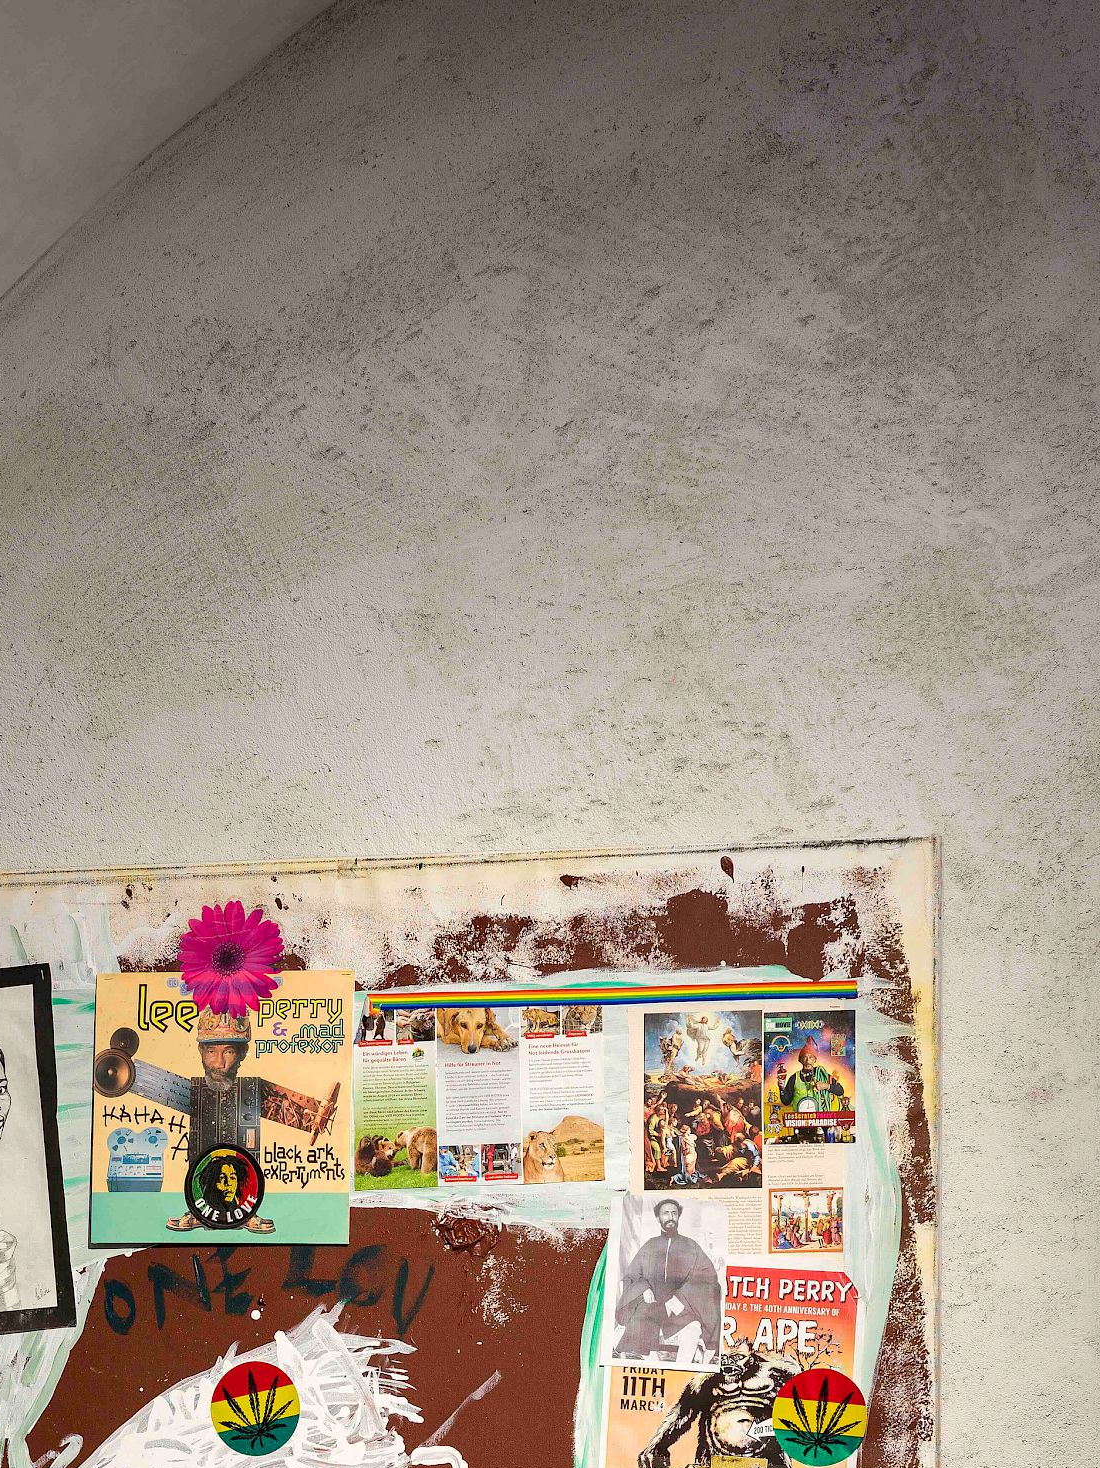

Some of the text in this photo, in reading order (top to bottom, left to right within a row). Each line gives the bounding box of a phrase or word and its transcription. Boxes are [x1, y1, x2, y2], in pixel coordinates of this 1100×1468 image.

[138, 984, 199, 1032] lee
[258, 998, 343, 1027] perry
[272, 1018, 345, 1038] & mad
[255, 1034, 344, 1058] professor
[808, 1119, 838, 1127] PARADISE
[264, 1142, 335, 1163] black ark
[194, 1194, 258, 1223] ONE LOVE
[726, 1276, 853, 1303] TCH PERRY
[750, 1304, 762, 1312] THE
[764, 1305, 782, 1313] 40TH
[783, 1306, 831, 1316] ANNIVERSARY
[832, 1308, 840, 1316] OF
[752, 1317, 818, 1353] APE
[622, 1376, 666, 1398] 11TH
[754, 1425, 764, 1435] 200
